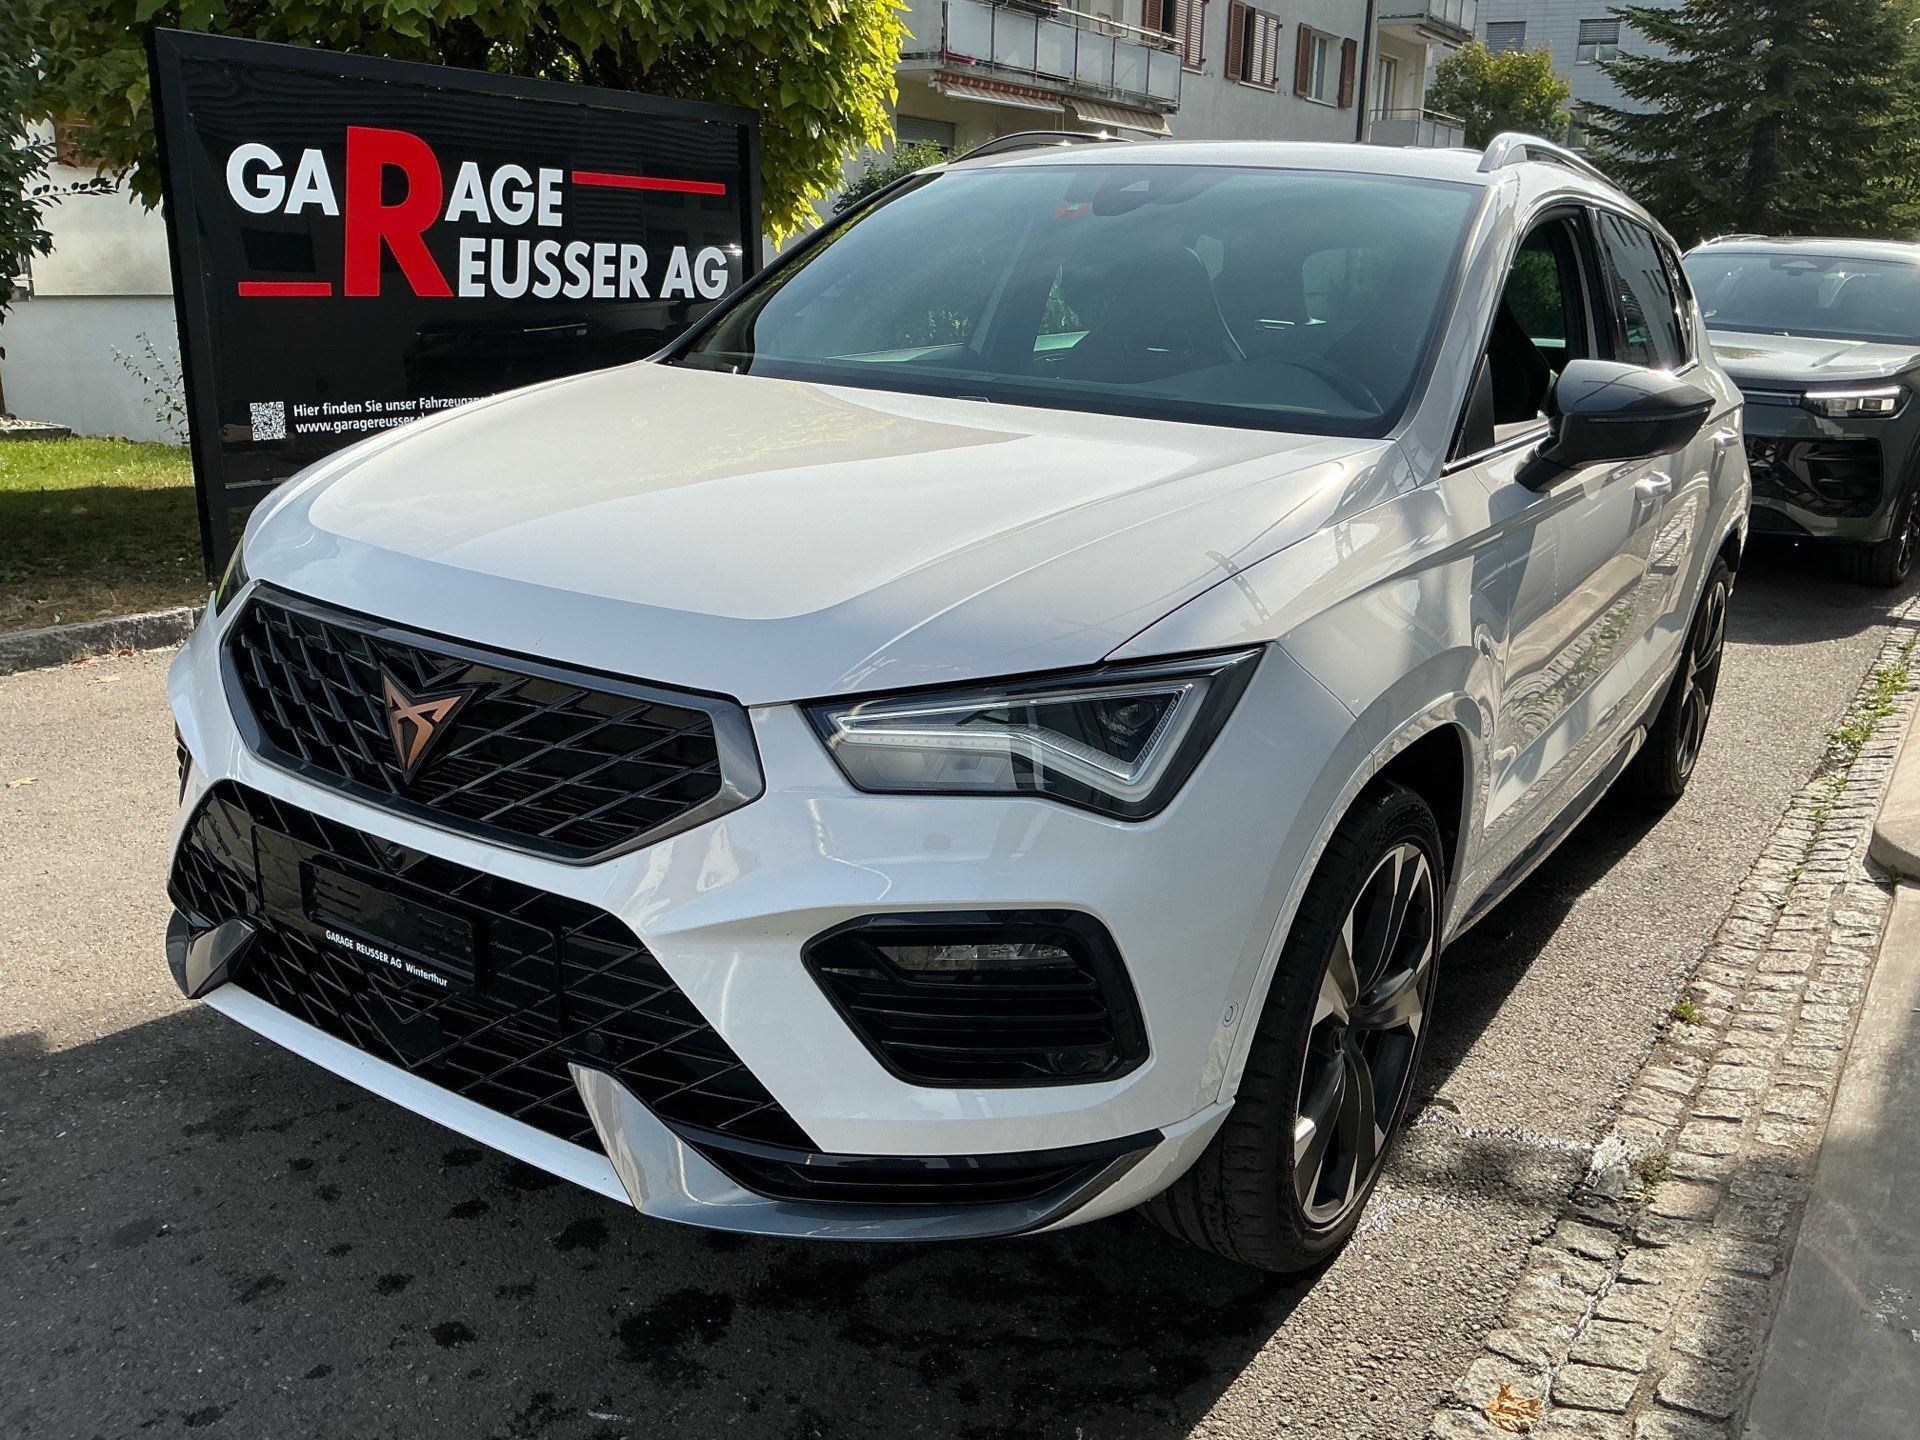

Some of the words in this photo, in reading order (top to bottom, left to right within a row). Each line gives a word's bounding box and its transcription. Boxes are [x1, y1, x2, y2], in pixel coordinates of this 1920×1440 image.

[660, 247, 729, 300] AG
[293, 404, 319, 417] Hier
[322, 402, 363, 416] finden
[365, 400, 383, 413] Sie
[386, 399, 417, 412] unser
[325, 929, 354, 950] GARAGE
[356, 941, 389, 963] REUSSER
[390, 956, 402, 970] AG
[405, 962, 448, 988] Winterthur
